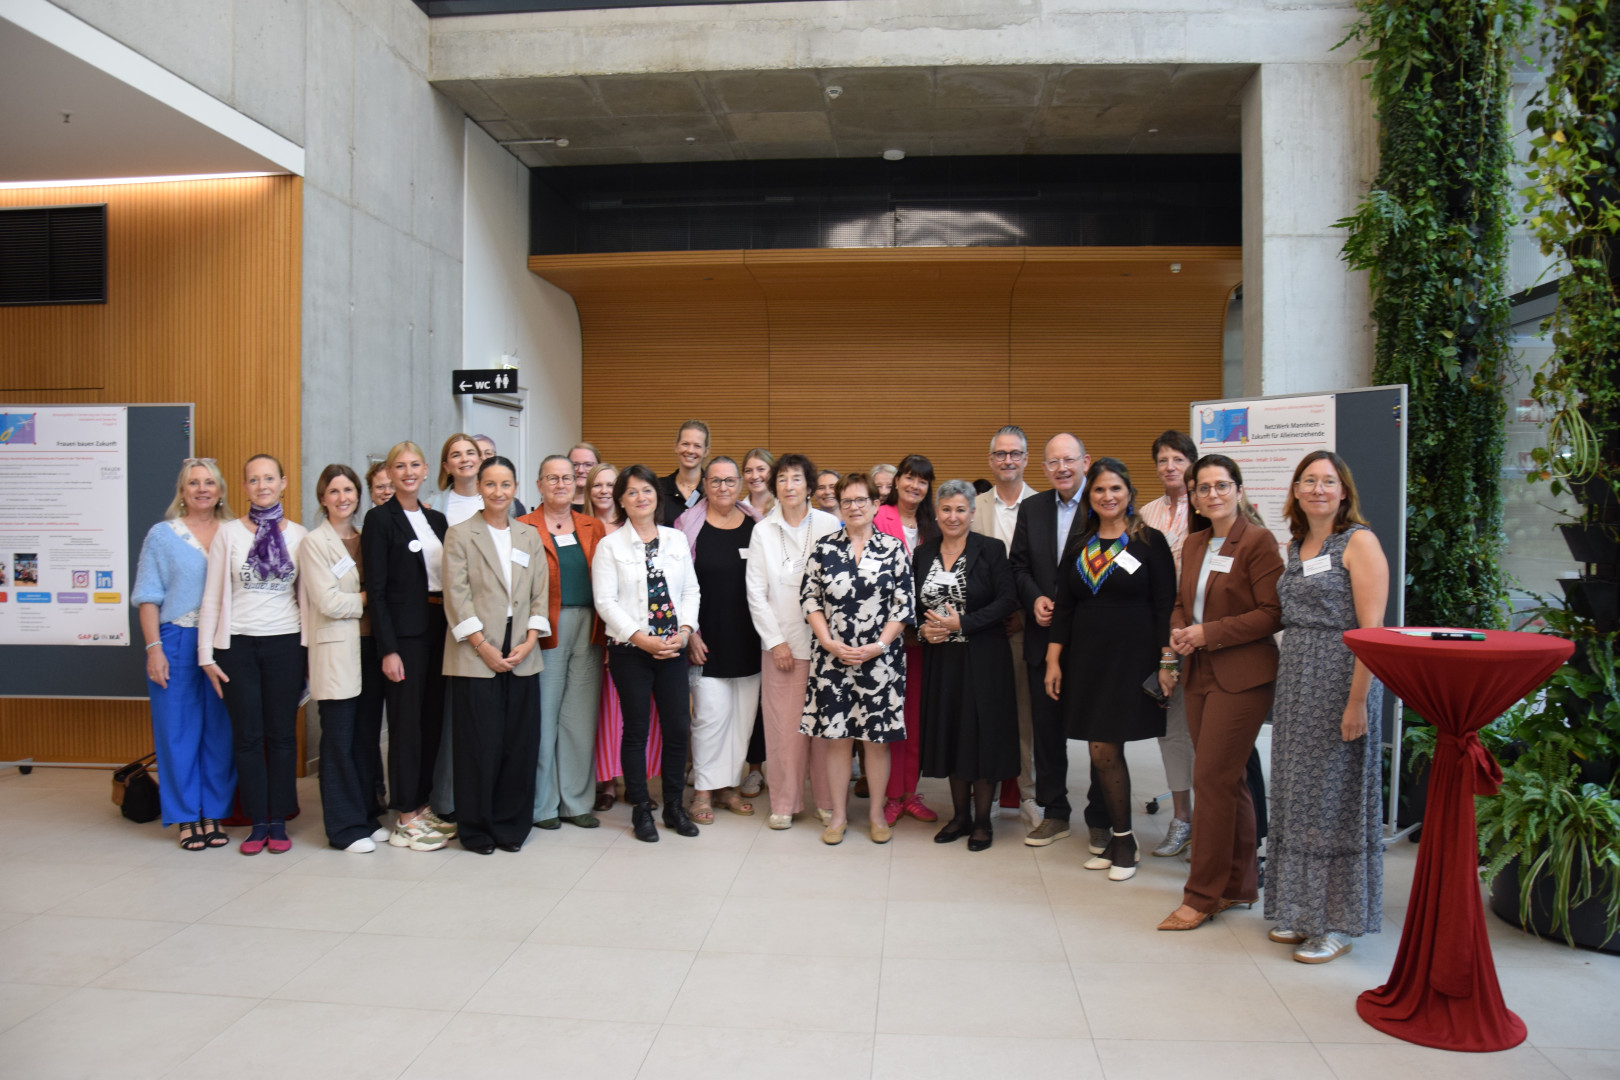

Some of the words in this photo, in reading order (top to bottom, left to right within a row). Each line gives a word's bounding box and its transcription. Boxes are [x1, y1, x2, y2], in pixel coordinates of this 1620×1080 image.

[475, 381, 491, 390] WC
[98, 573, 112, 586] in
[239, 572, 251, 582] 13
